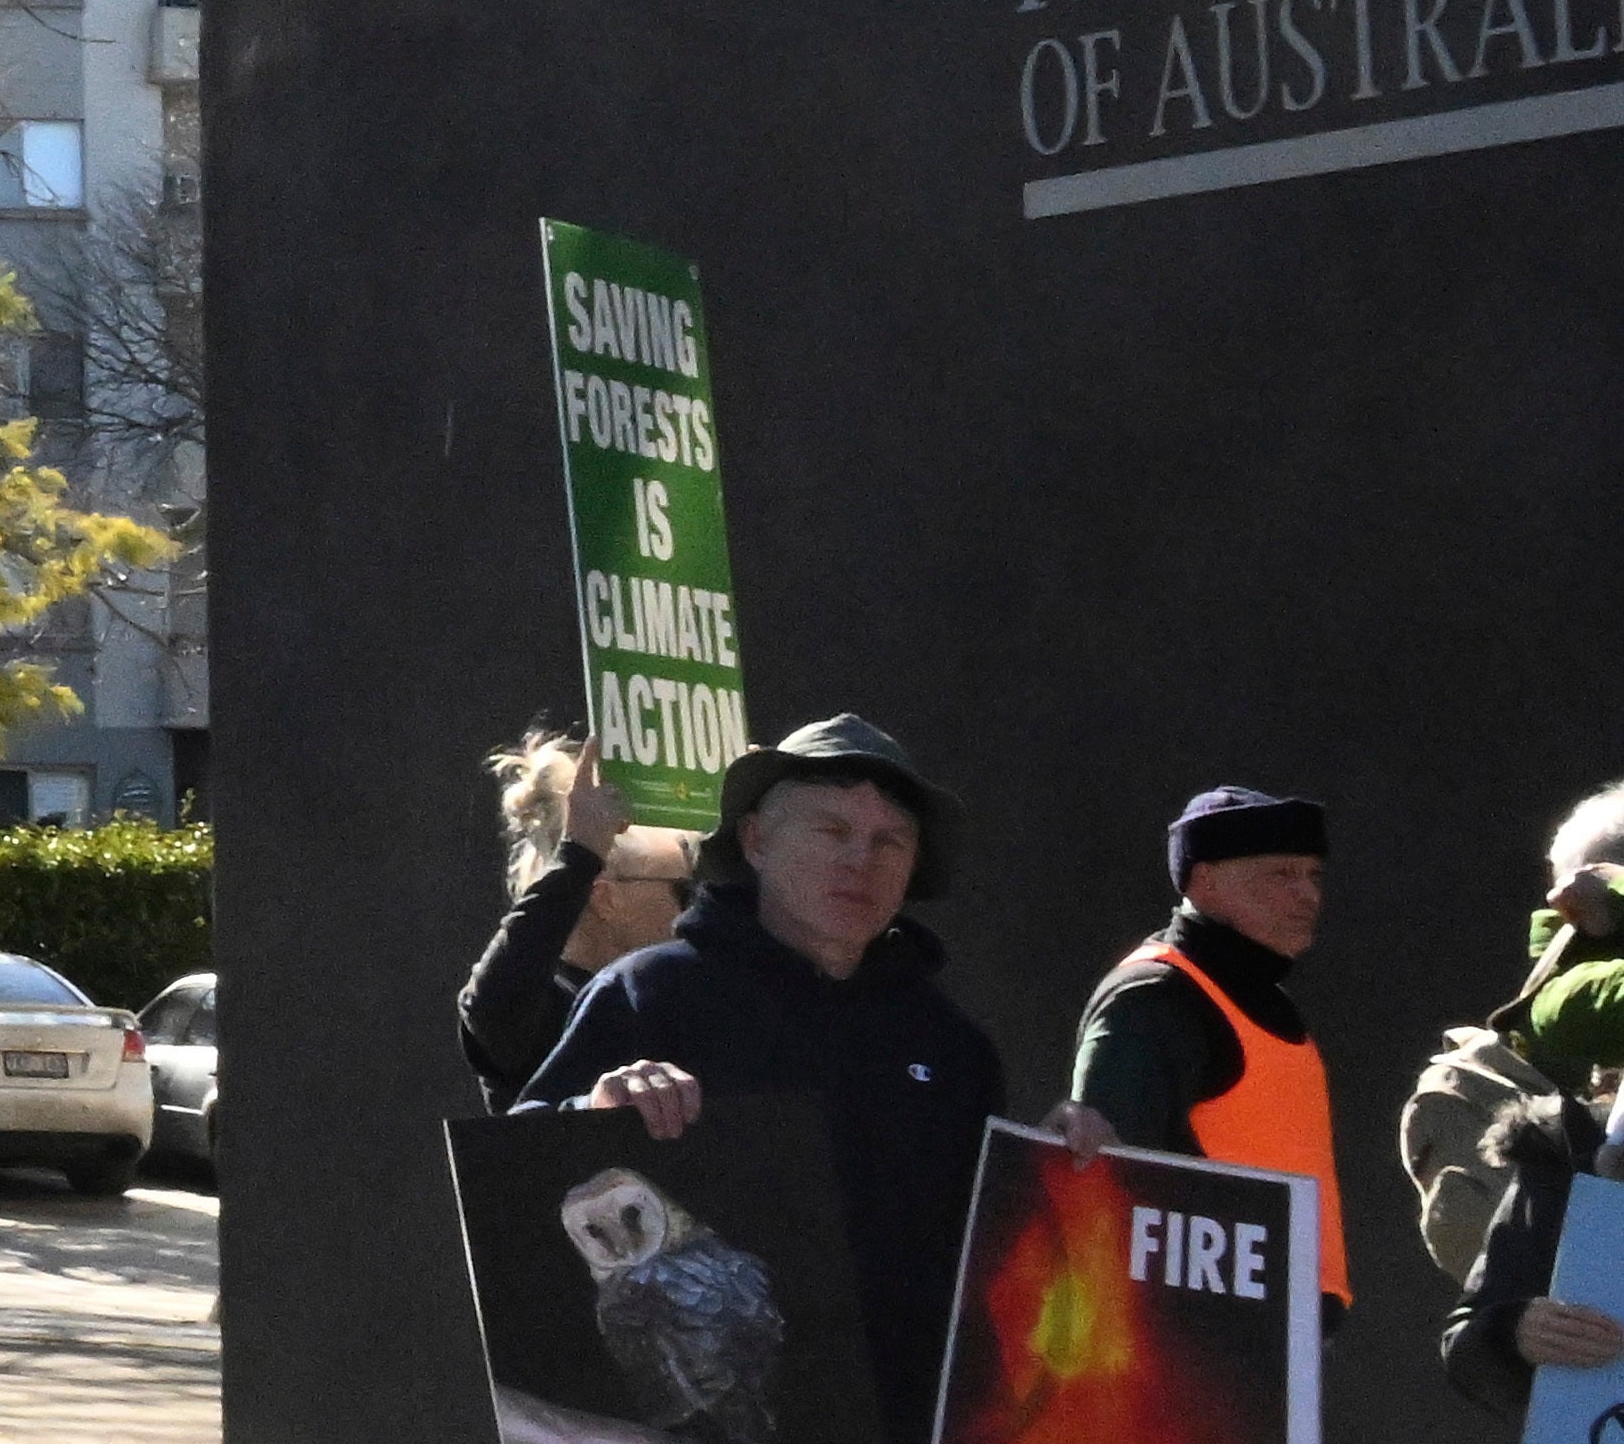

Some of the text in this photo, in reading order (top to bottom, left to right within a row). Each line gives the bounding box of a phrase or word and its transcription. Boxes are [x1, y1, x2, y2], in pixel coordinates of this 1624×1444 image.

[1020, 30, 1122, 156] OF
[564, 270, 699, 379] SAVING
[564, 369, 715, 473] FORESTS
[632, 477, 674, 562] IS
[586, 568, 737, 669] CLIMATE
[600, 670, 749, 775] ACTION
[1130, 1205, 1268, 1300] FIRE
